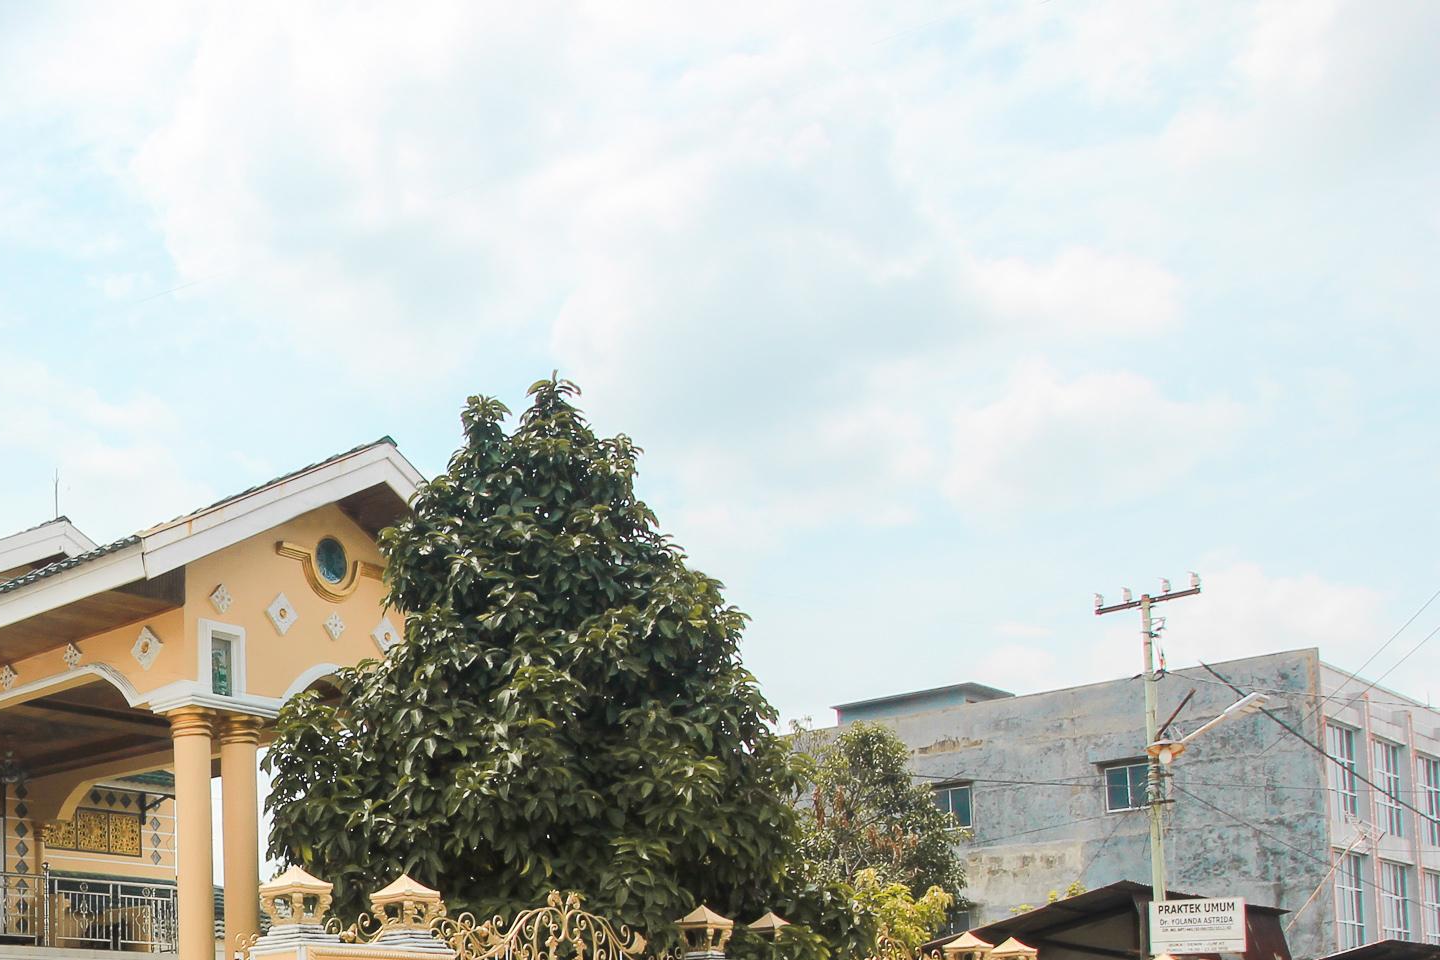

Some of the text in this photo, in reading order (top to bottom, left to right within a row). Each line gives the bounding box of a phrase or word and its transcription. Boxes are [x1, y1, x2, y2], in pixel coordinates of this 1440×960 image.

[1158, 902, 1235, 914] PRAKTEK UMUM
[1171, 917, 1202, 925] YOLANDA
[1204, 916, 1233, 924] ASTRIDA
